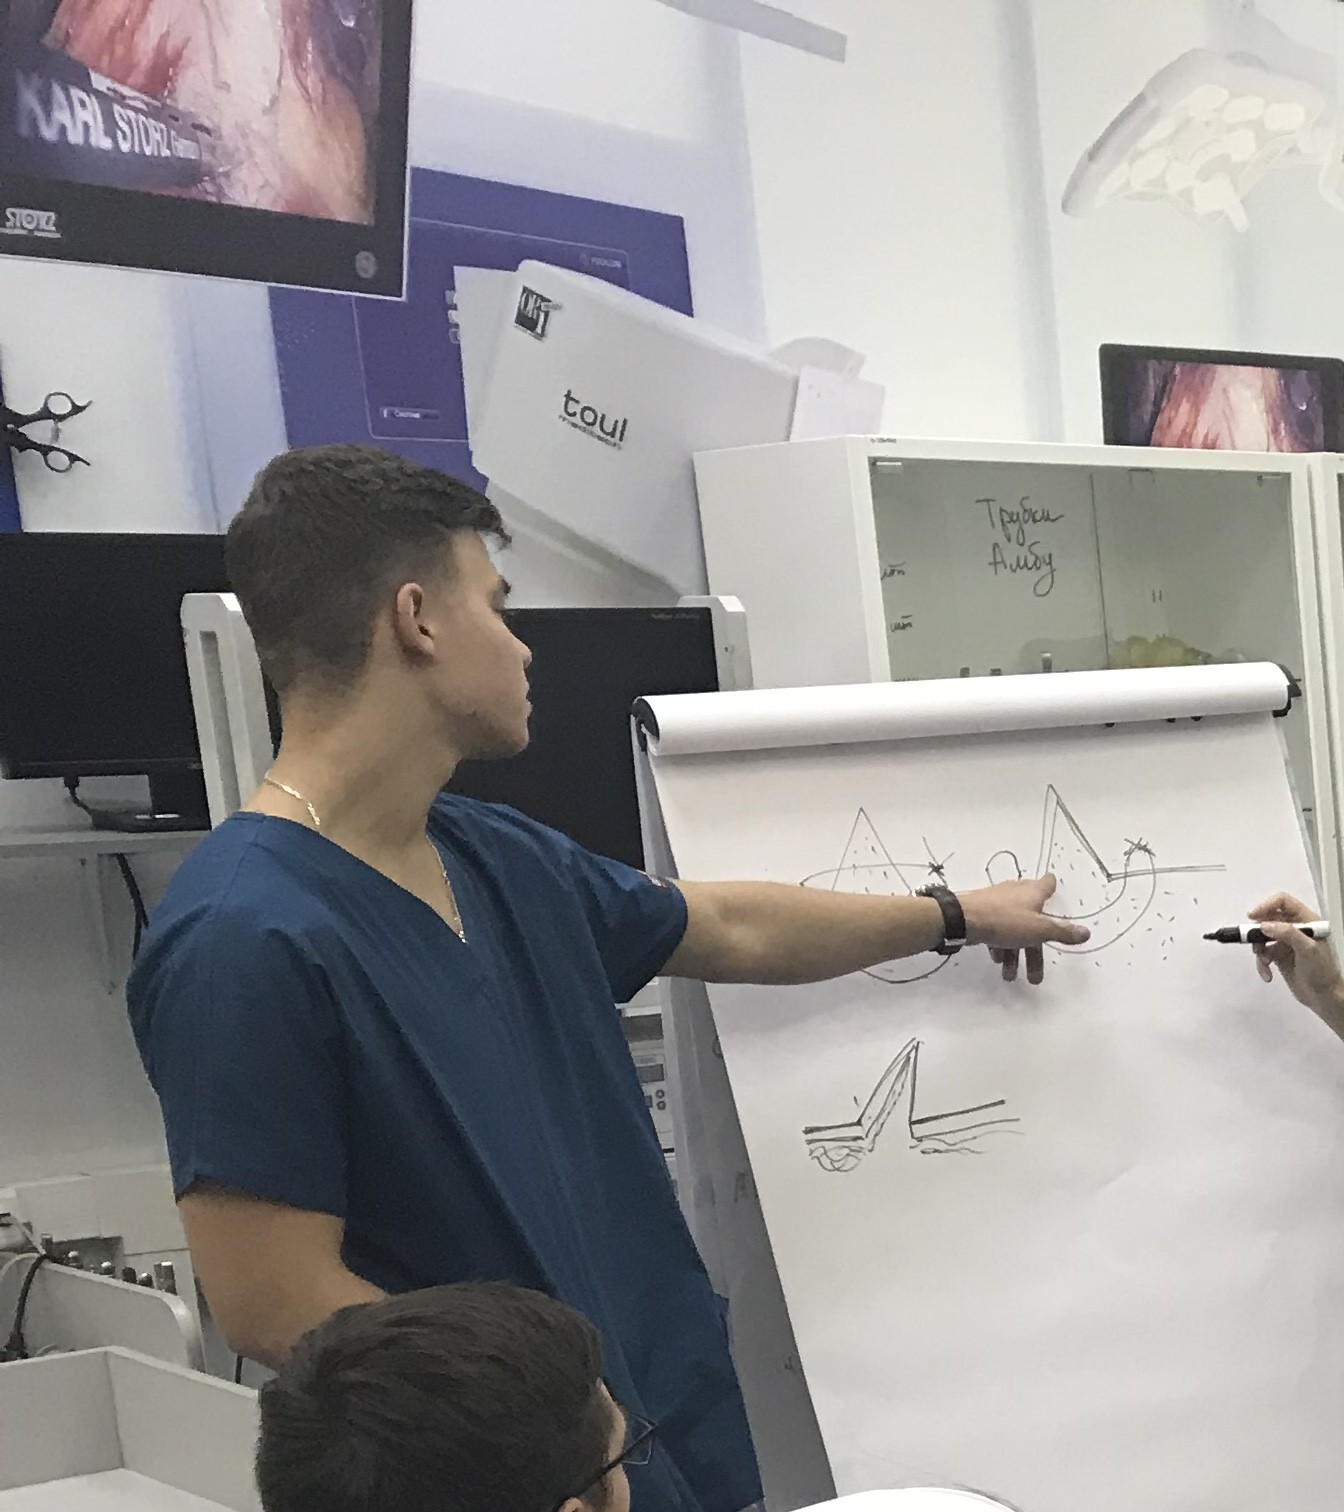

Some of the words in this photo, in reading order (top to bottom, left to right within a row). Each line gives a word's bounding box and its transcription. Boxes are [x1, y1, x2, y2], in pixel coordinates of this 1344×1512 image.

[16, 68, 113, 150] KARL
[113, 102, 171, 158] STORZ
[5, 207, 57, 232] STORZ
[563, 389, 628, 442] toul
[988, 540, 1056, 598] Амбу
